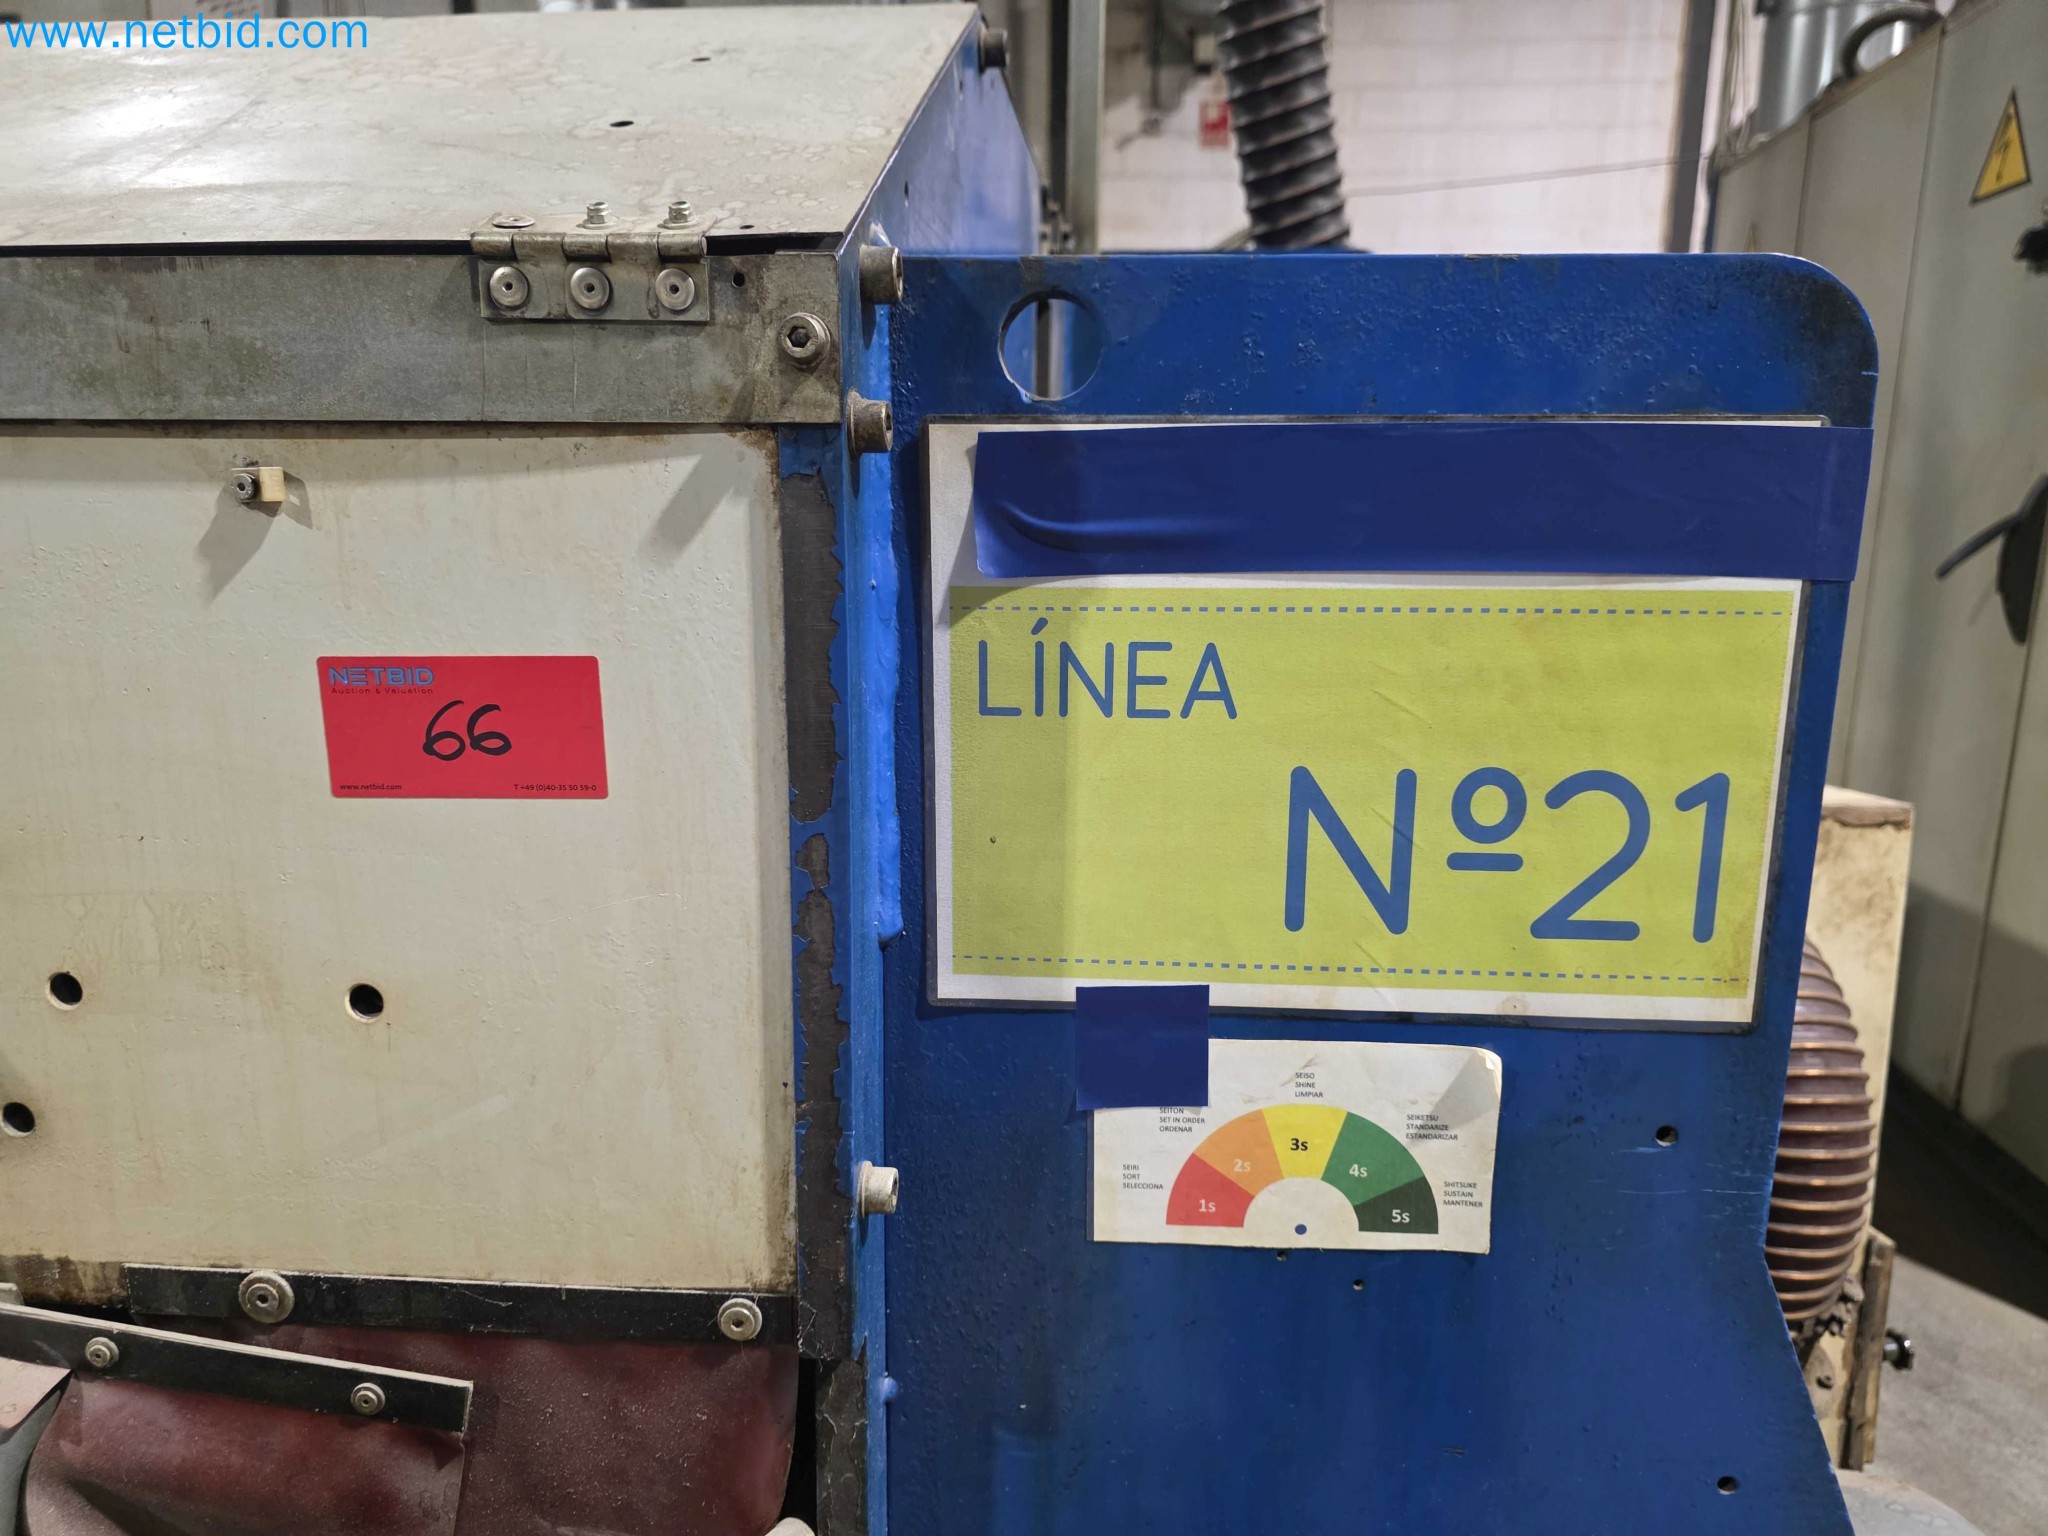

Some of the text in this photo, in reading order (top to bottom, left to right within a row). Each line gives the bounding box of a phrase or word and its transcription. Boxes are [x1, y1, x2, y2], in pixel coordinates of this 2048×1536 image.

[978, 616, 1238, 720] LÍNEA
[328, 667, 434, 686] NETBID
[331, 687, 371, 695] Auction
[422, 700, 513, 762] 66
[339, 783, 403, 791] www.netbid.com
[535, 783, 567, 792] (0)40-35
[1406, 1123, 1449, 1131] STANDARIZE
[1405, 1132, 1458, 1140] ESTANDARIZAR
[1290, 1137, 1308, 1151] 3s
[1233, 1159, 1251, 1172] 2s
[1349, 1163, 1367, 1178] 4s
[1122, 1182, 1164, 1190] SELECCIONA
[1444, 1181, 1477, 1189] SHITSUKE
[1443, 1190, 1473, 1198] SUSTAIN
[1198, 1199, 1216, 1213] 1s
[1443, 1199, 1483, 1208] MANTENER
[1391, 1209, 1410, 1223] 5s
